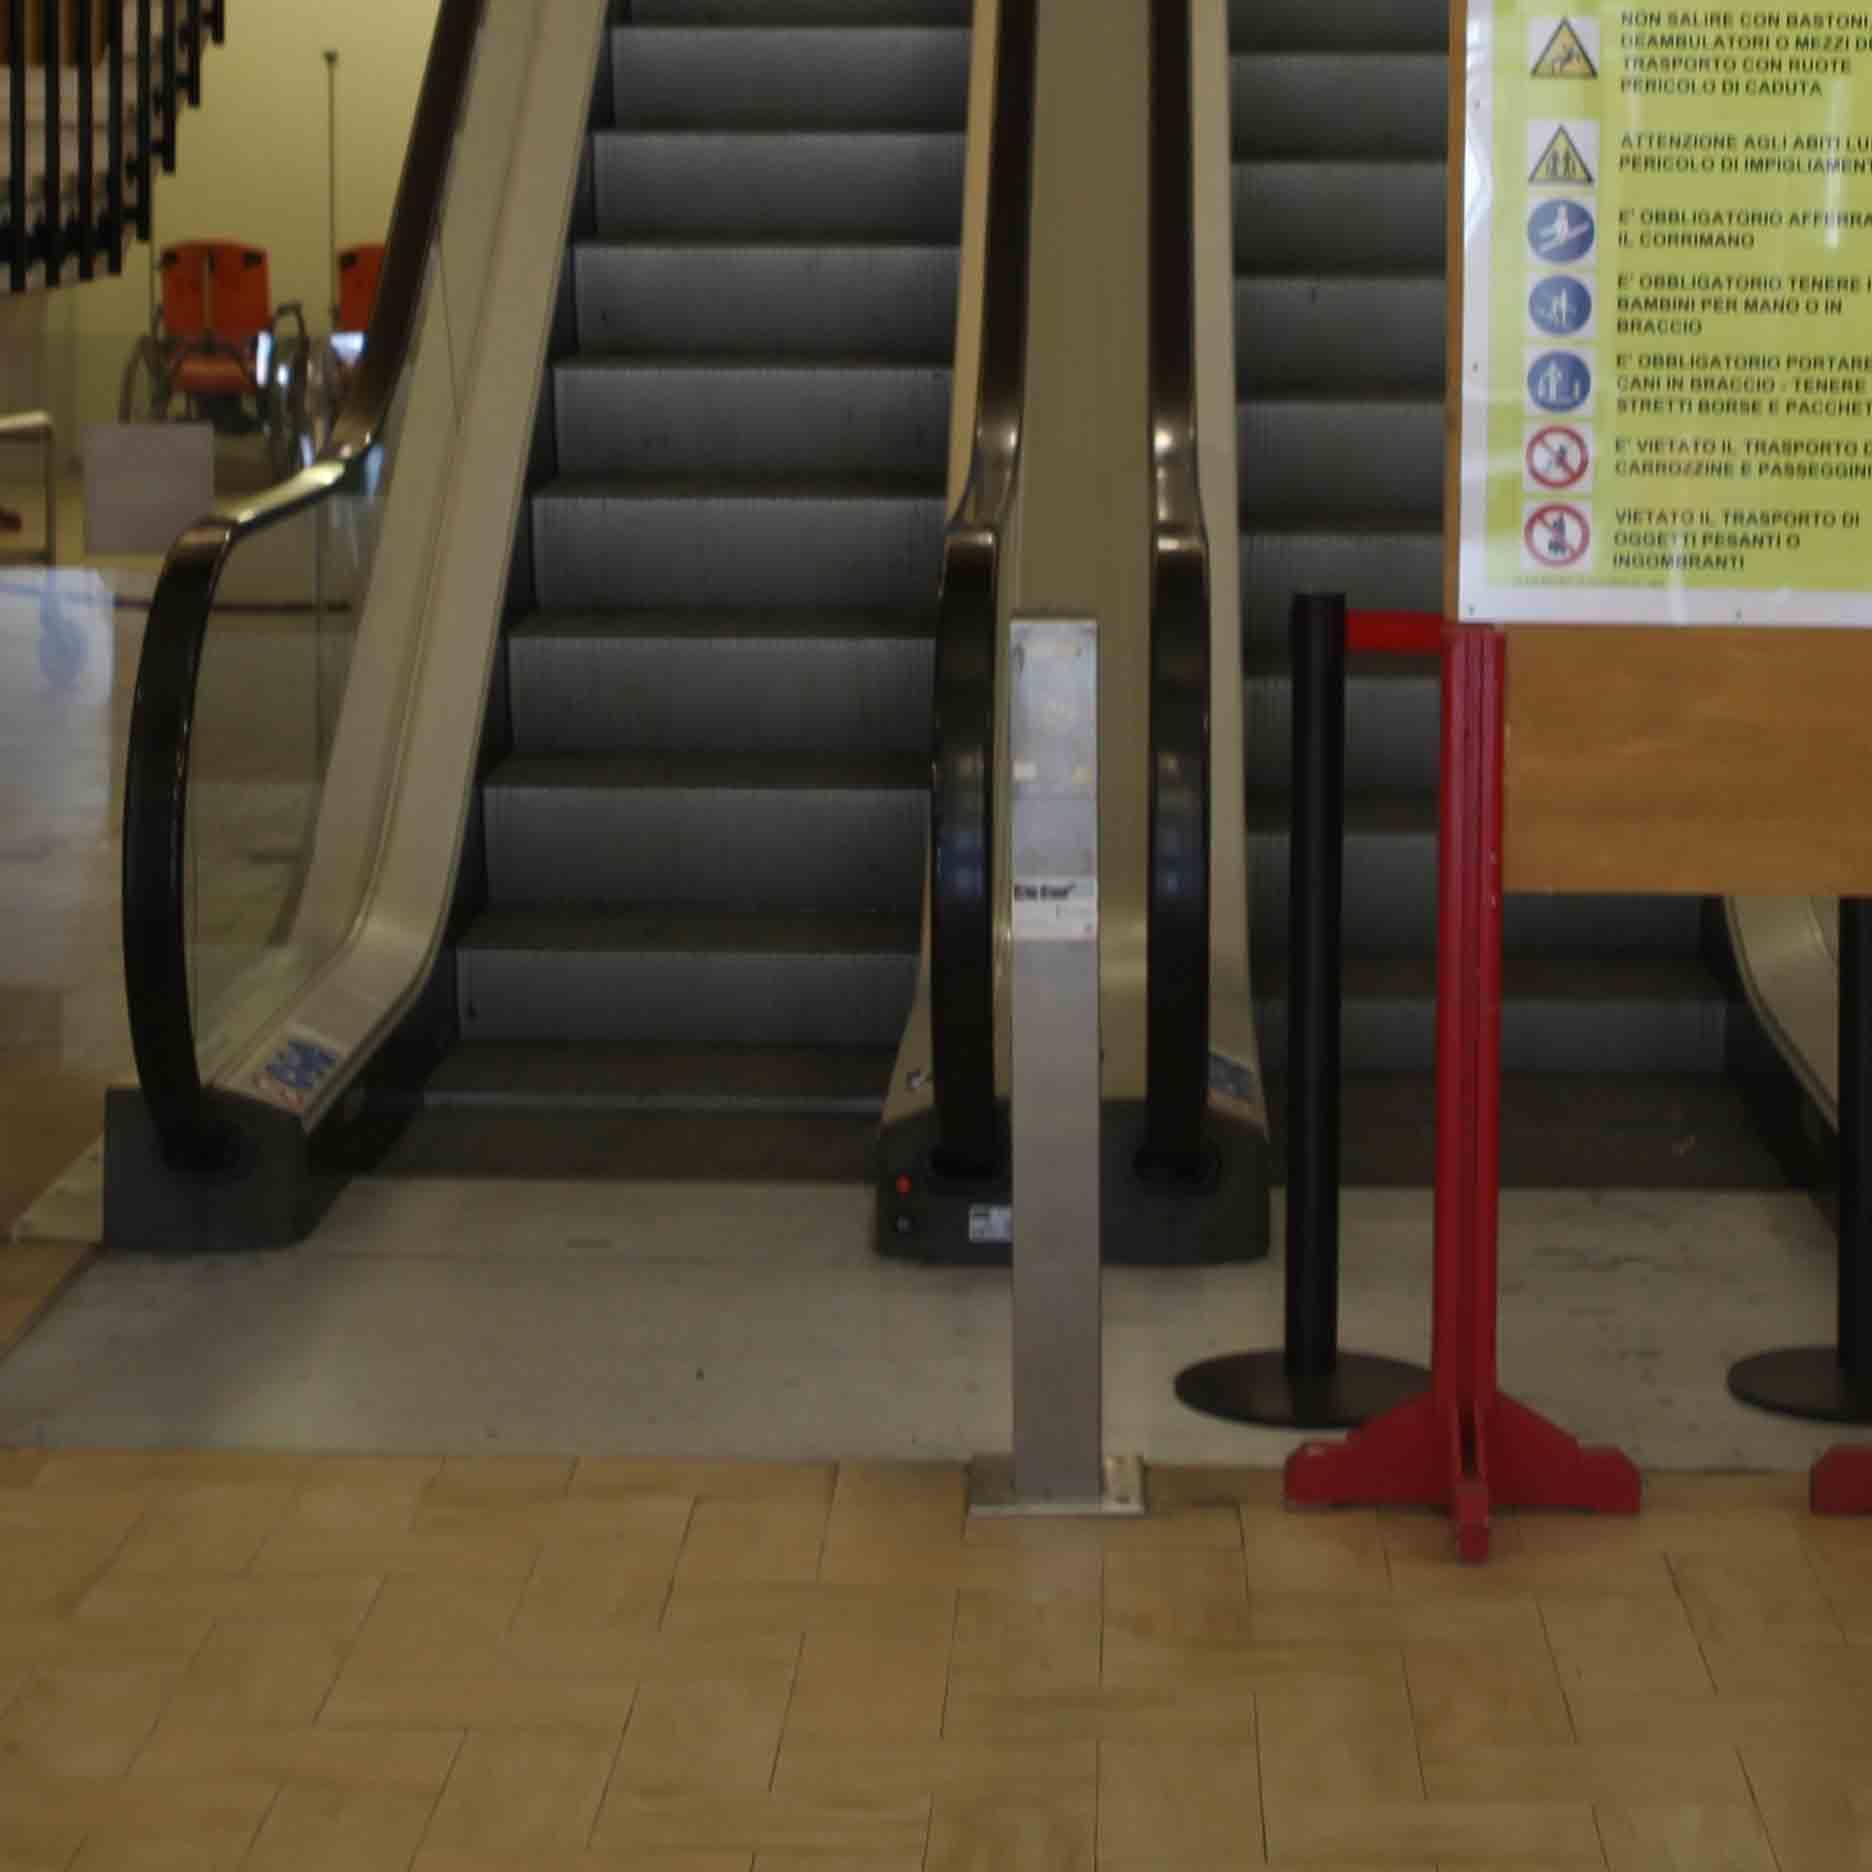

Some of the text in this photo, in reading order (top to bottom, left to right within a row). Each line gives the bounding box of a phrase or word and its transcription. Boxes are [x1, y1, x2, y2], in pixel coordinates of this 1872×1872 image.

[1621, 10, 1662, 27] NON
[1667, 10, 1734, 27] SALIRE
[1740, 11, 1780, 28] CON
[1621, 33, 1771, 50] DEAMBULATORI
[1795, 34, 1849, 51] MEZZI
[1856, 35, 1872, 51] DI
[1623, 56, 1852, 74] TRASPORTO CON RUOTE
[1621, 78, 1823, 96] PERICOLO DI CADUTA
[1620, 133, 1736, 150] ATTENZIONE
[1744, 134, 1786, 151] AGLI
[1792, 134, 1840, 151] ABITI
[1619, 156, 1715, 173] PERICOLO
[1720, 156, 1739, 173] DI
[1639, 209, 1782, 227] OBBLIGATORIO
[1618, 231, 1755, 249] IL CORRIMANO
[1639, 274, 1782, 292] OBBLIGATORIO
[1789, 276, 1861, 292] TENERE
[1616, 296, 1695, 313] BAMBINI
[1701, 297, 1737, 314] PER
[1743, 298, 1800, 314] MANO
[1824, 298, 1843, 315] IN
[1616, 319, 1703, 335] BRACCIO
[1638, 353, 1781, 370] OBBLIGATORIO
[1616, 376, 1661, 392] CANI
[1666, 377, 1684, 392] IN
[1690, 377, 1776, 393] BRACCIO
[1793, 378, 1867, 394] TENERE
[1616, 399, 1694, 415] STRETTI
[1698, 399, 1764, 416] BORSE
[1636, 438, 1717, 455] VIETATO
[1744, 439, 1859, 457] TRASPORTO
[1615, 461, 1732, 478] CARROZZINE
[1758, 463, 1872, 479] PASSEGGINI
[1614, 510, 1695, 526] VIETATO
[1723, 511, 1837, 528] TRASPORTO
[1842, 512, 1861, 528] DI
[1613, 532, 1697, 548] OGGETTI
[1702, 532, 1781, 549] PESANTI
[1613, 553, 1745, 570] INGOMBRANTI
